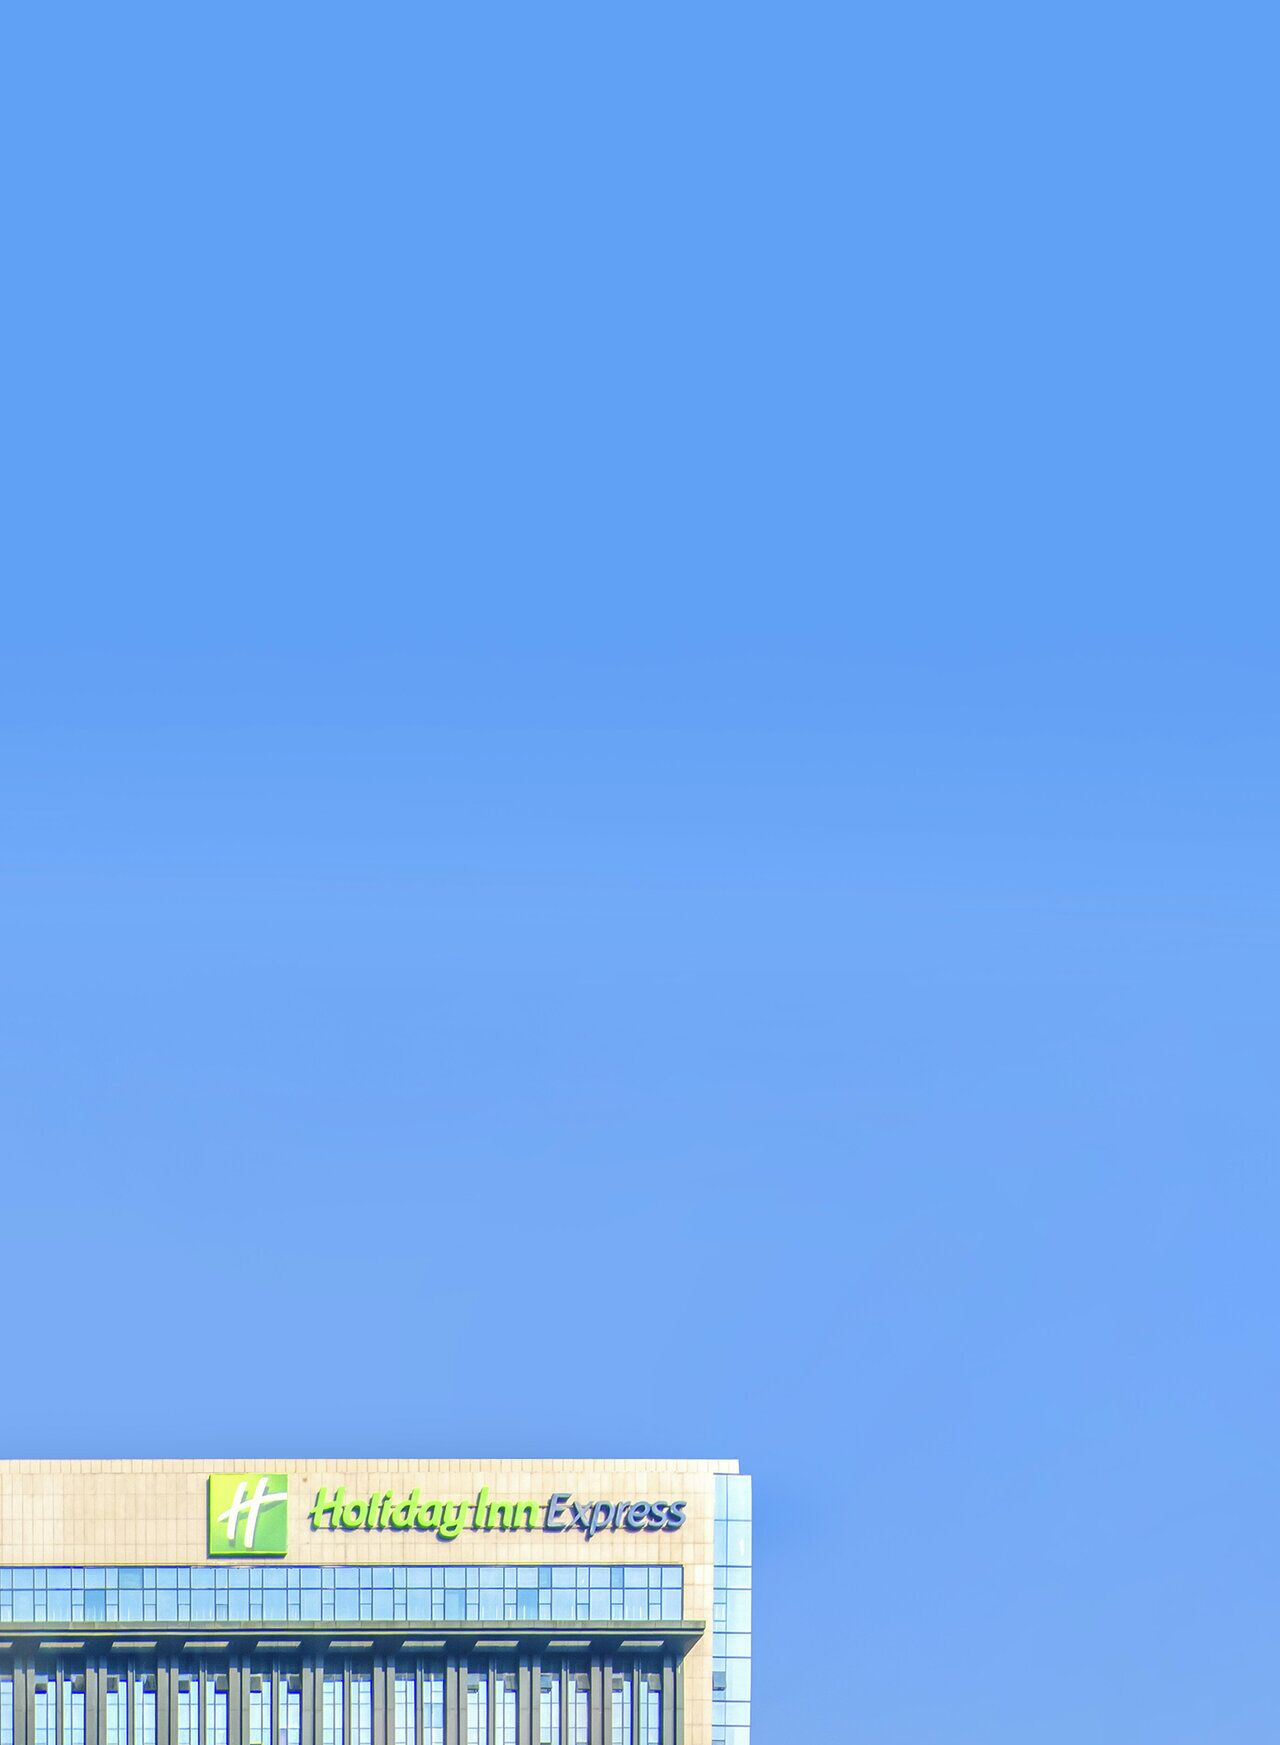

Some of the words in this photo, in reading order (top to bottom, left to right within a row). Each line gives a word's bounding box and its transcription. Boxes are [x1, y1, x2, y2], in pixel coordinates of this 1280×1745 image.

[309, 1487, 469, 1539] Holiday
[474, 1486, 540, 1529] Inn
[545, 1492, 688, 1537] Express
